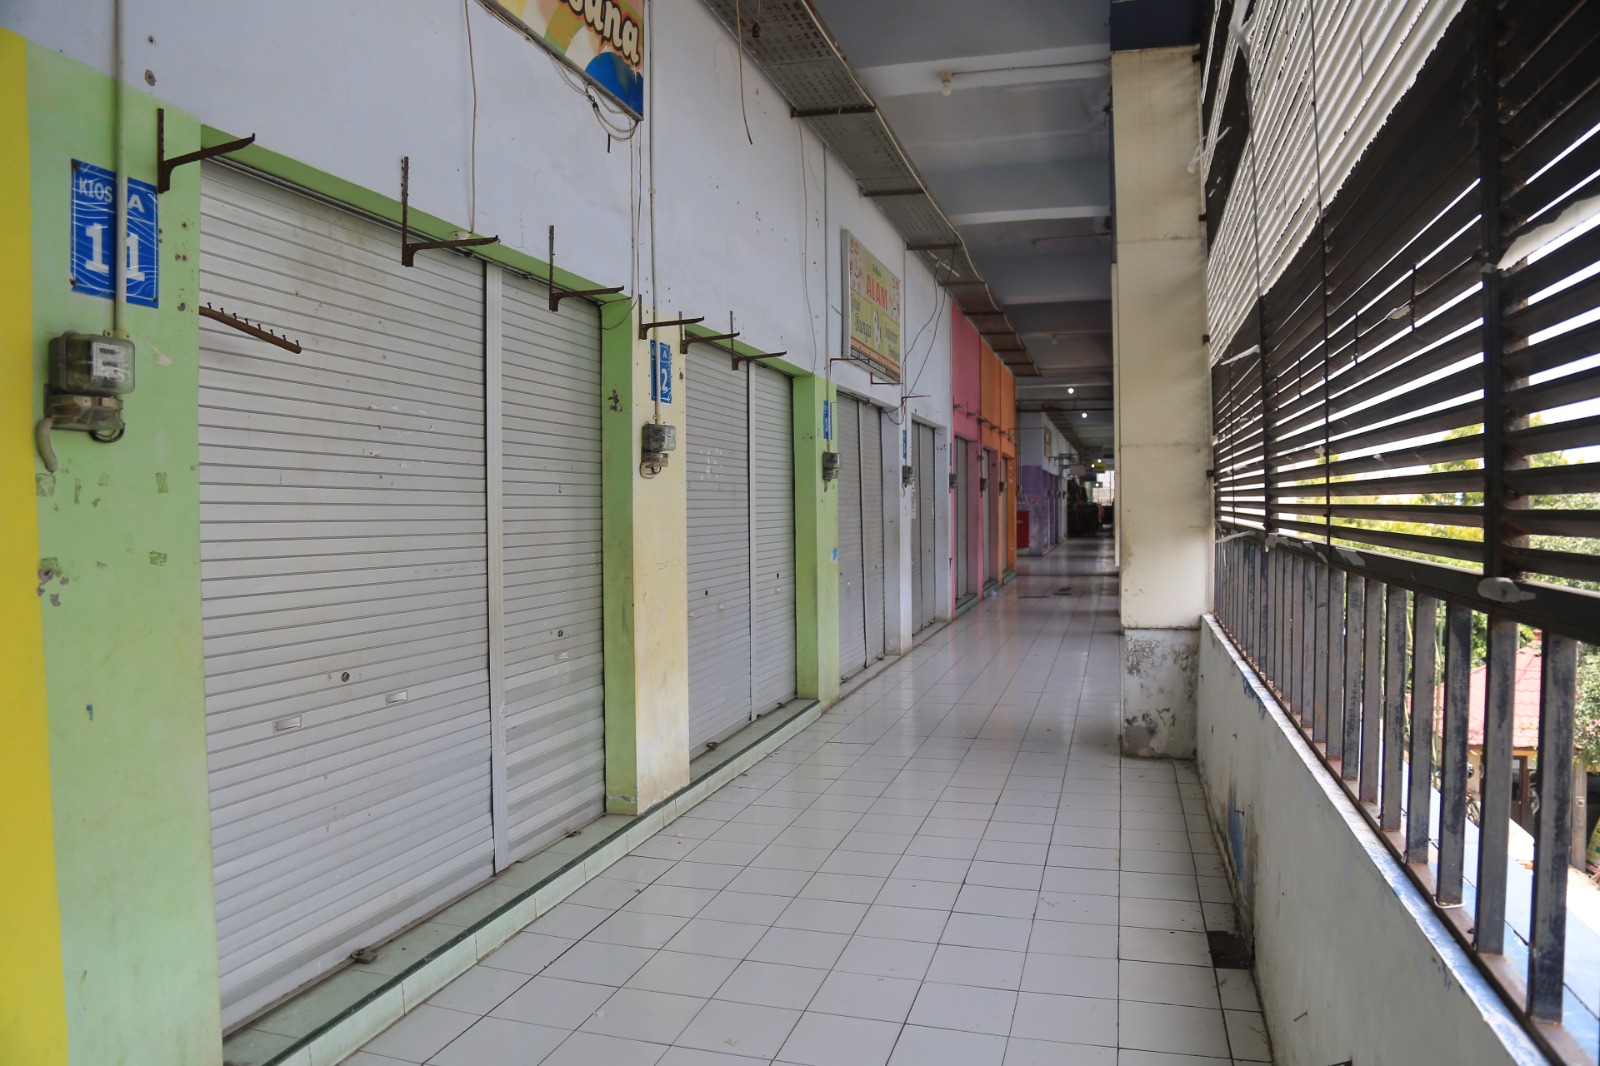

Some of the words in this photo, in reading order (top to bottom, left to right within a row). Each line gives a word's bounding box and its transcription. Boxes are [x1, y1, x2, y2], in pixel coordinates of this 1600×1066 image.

[79, 177, 113, 203] KIOS
[127, 194, 145, 213] A
[866, 273, 888, 311] ALAM
